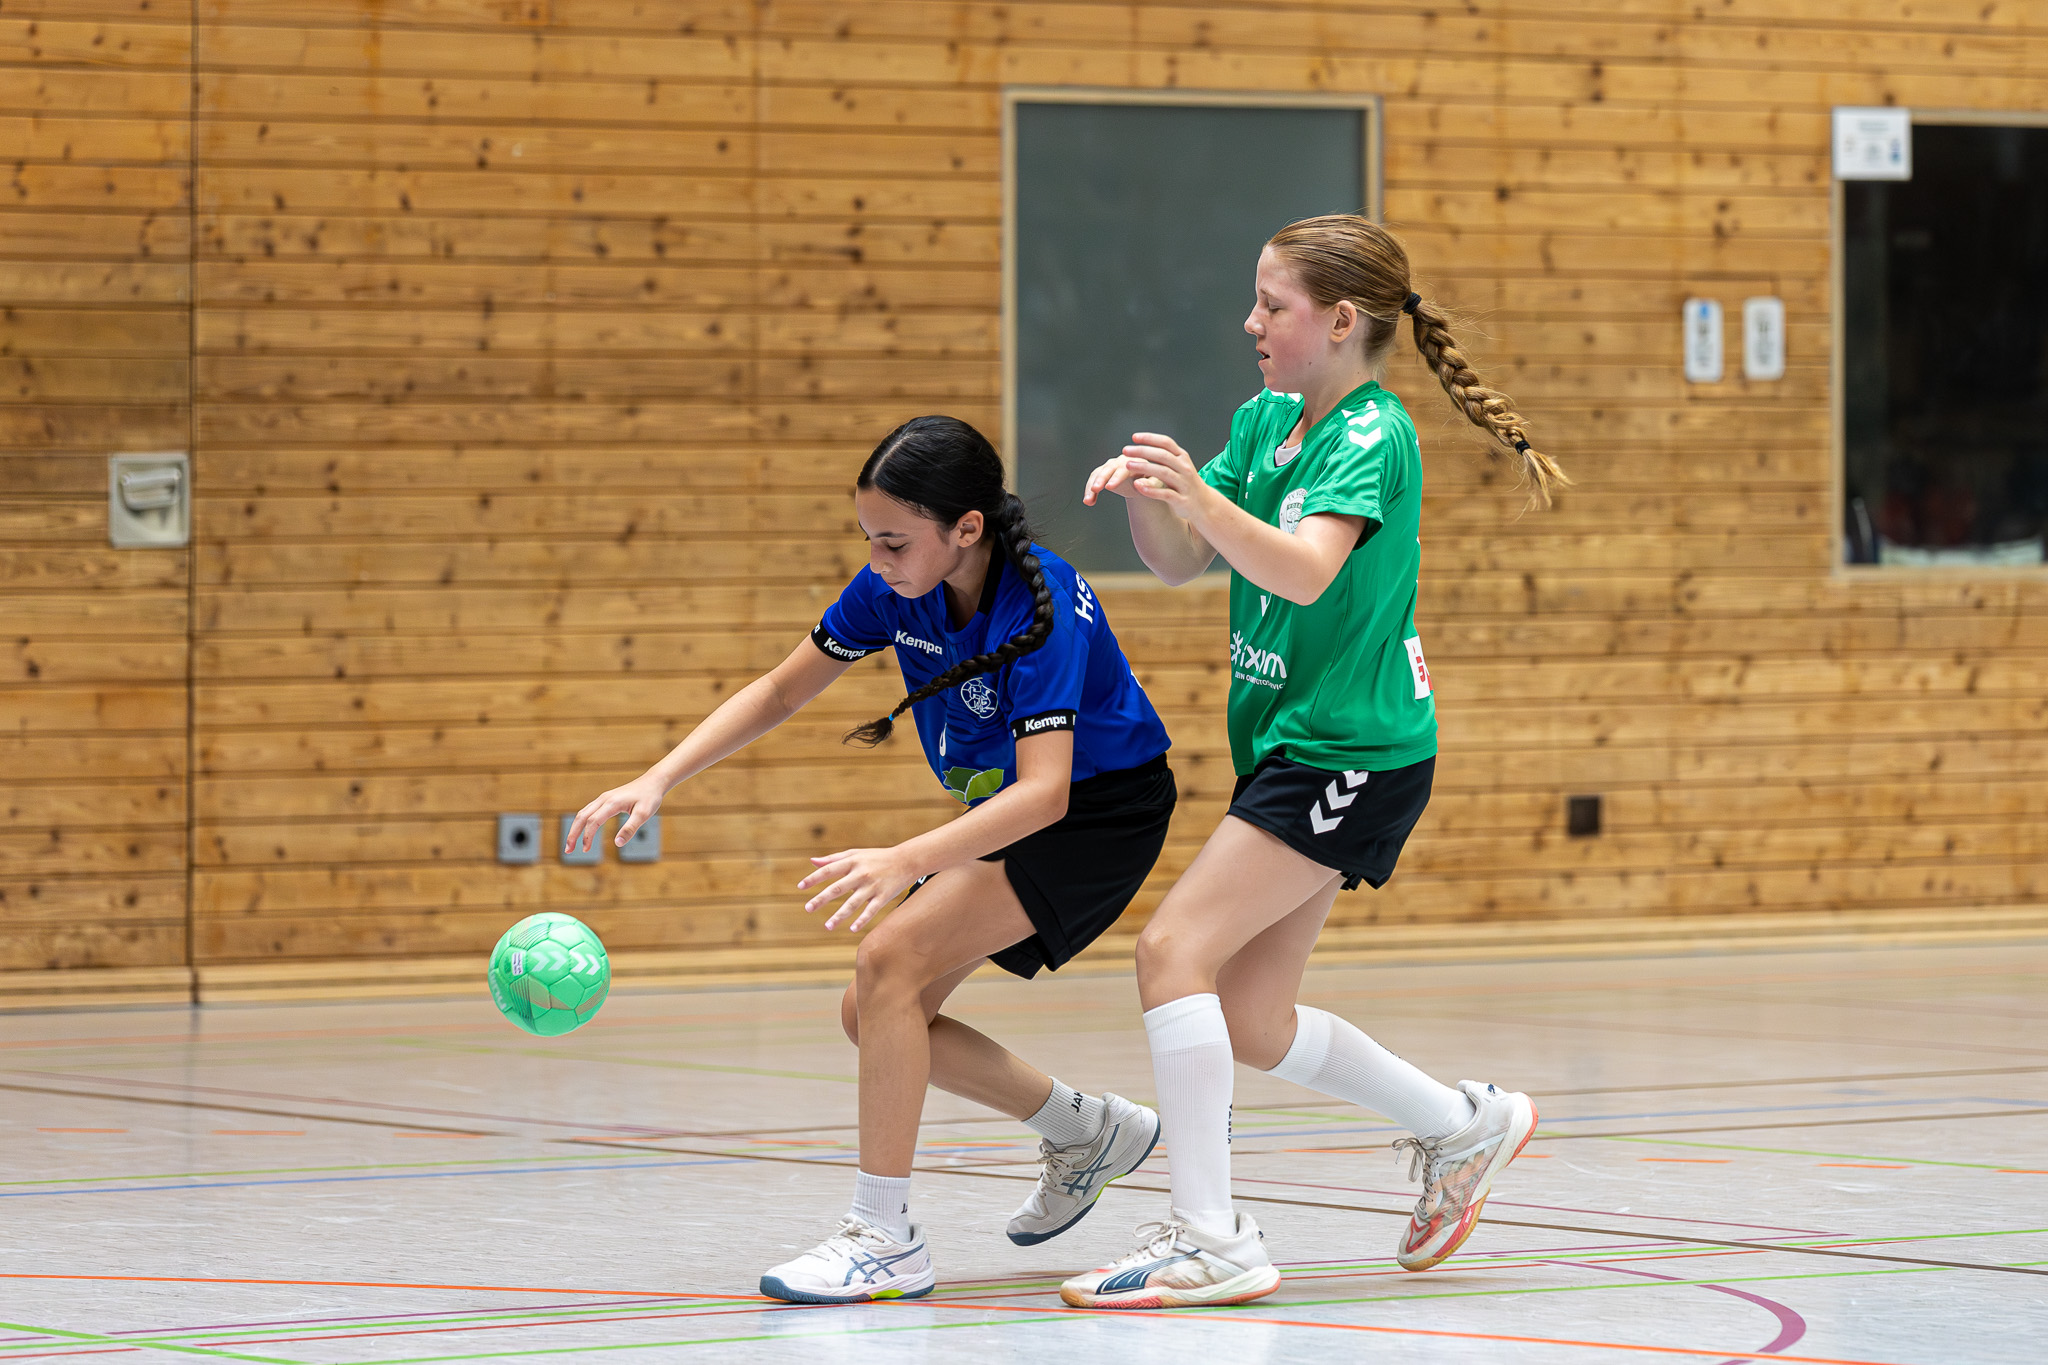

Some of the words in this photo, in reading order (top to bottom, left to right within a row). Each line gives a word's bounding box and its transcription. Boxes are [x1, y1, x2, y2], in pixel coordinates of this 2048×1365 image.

[823, 636, 866, 660] Kempa
[895, 630, 943, 655] Kempa
[1025, 715, 1067, 732] Kempa
